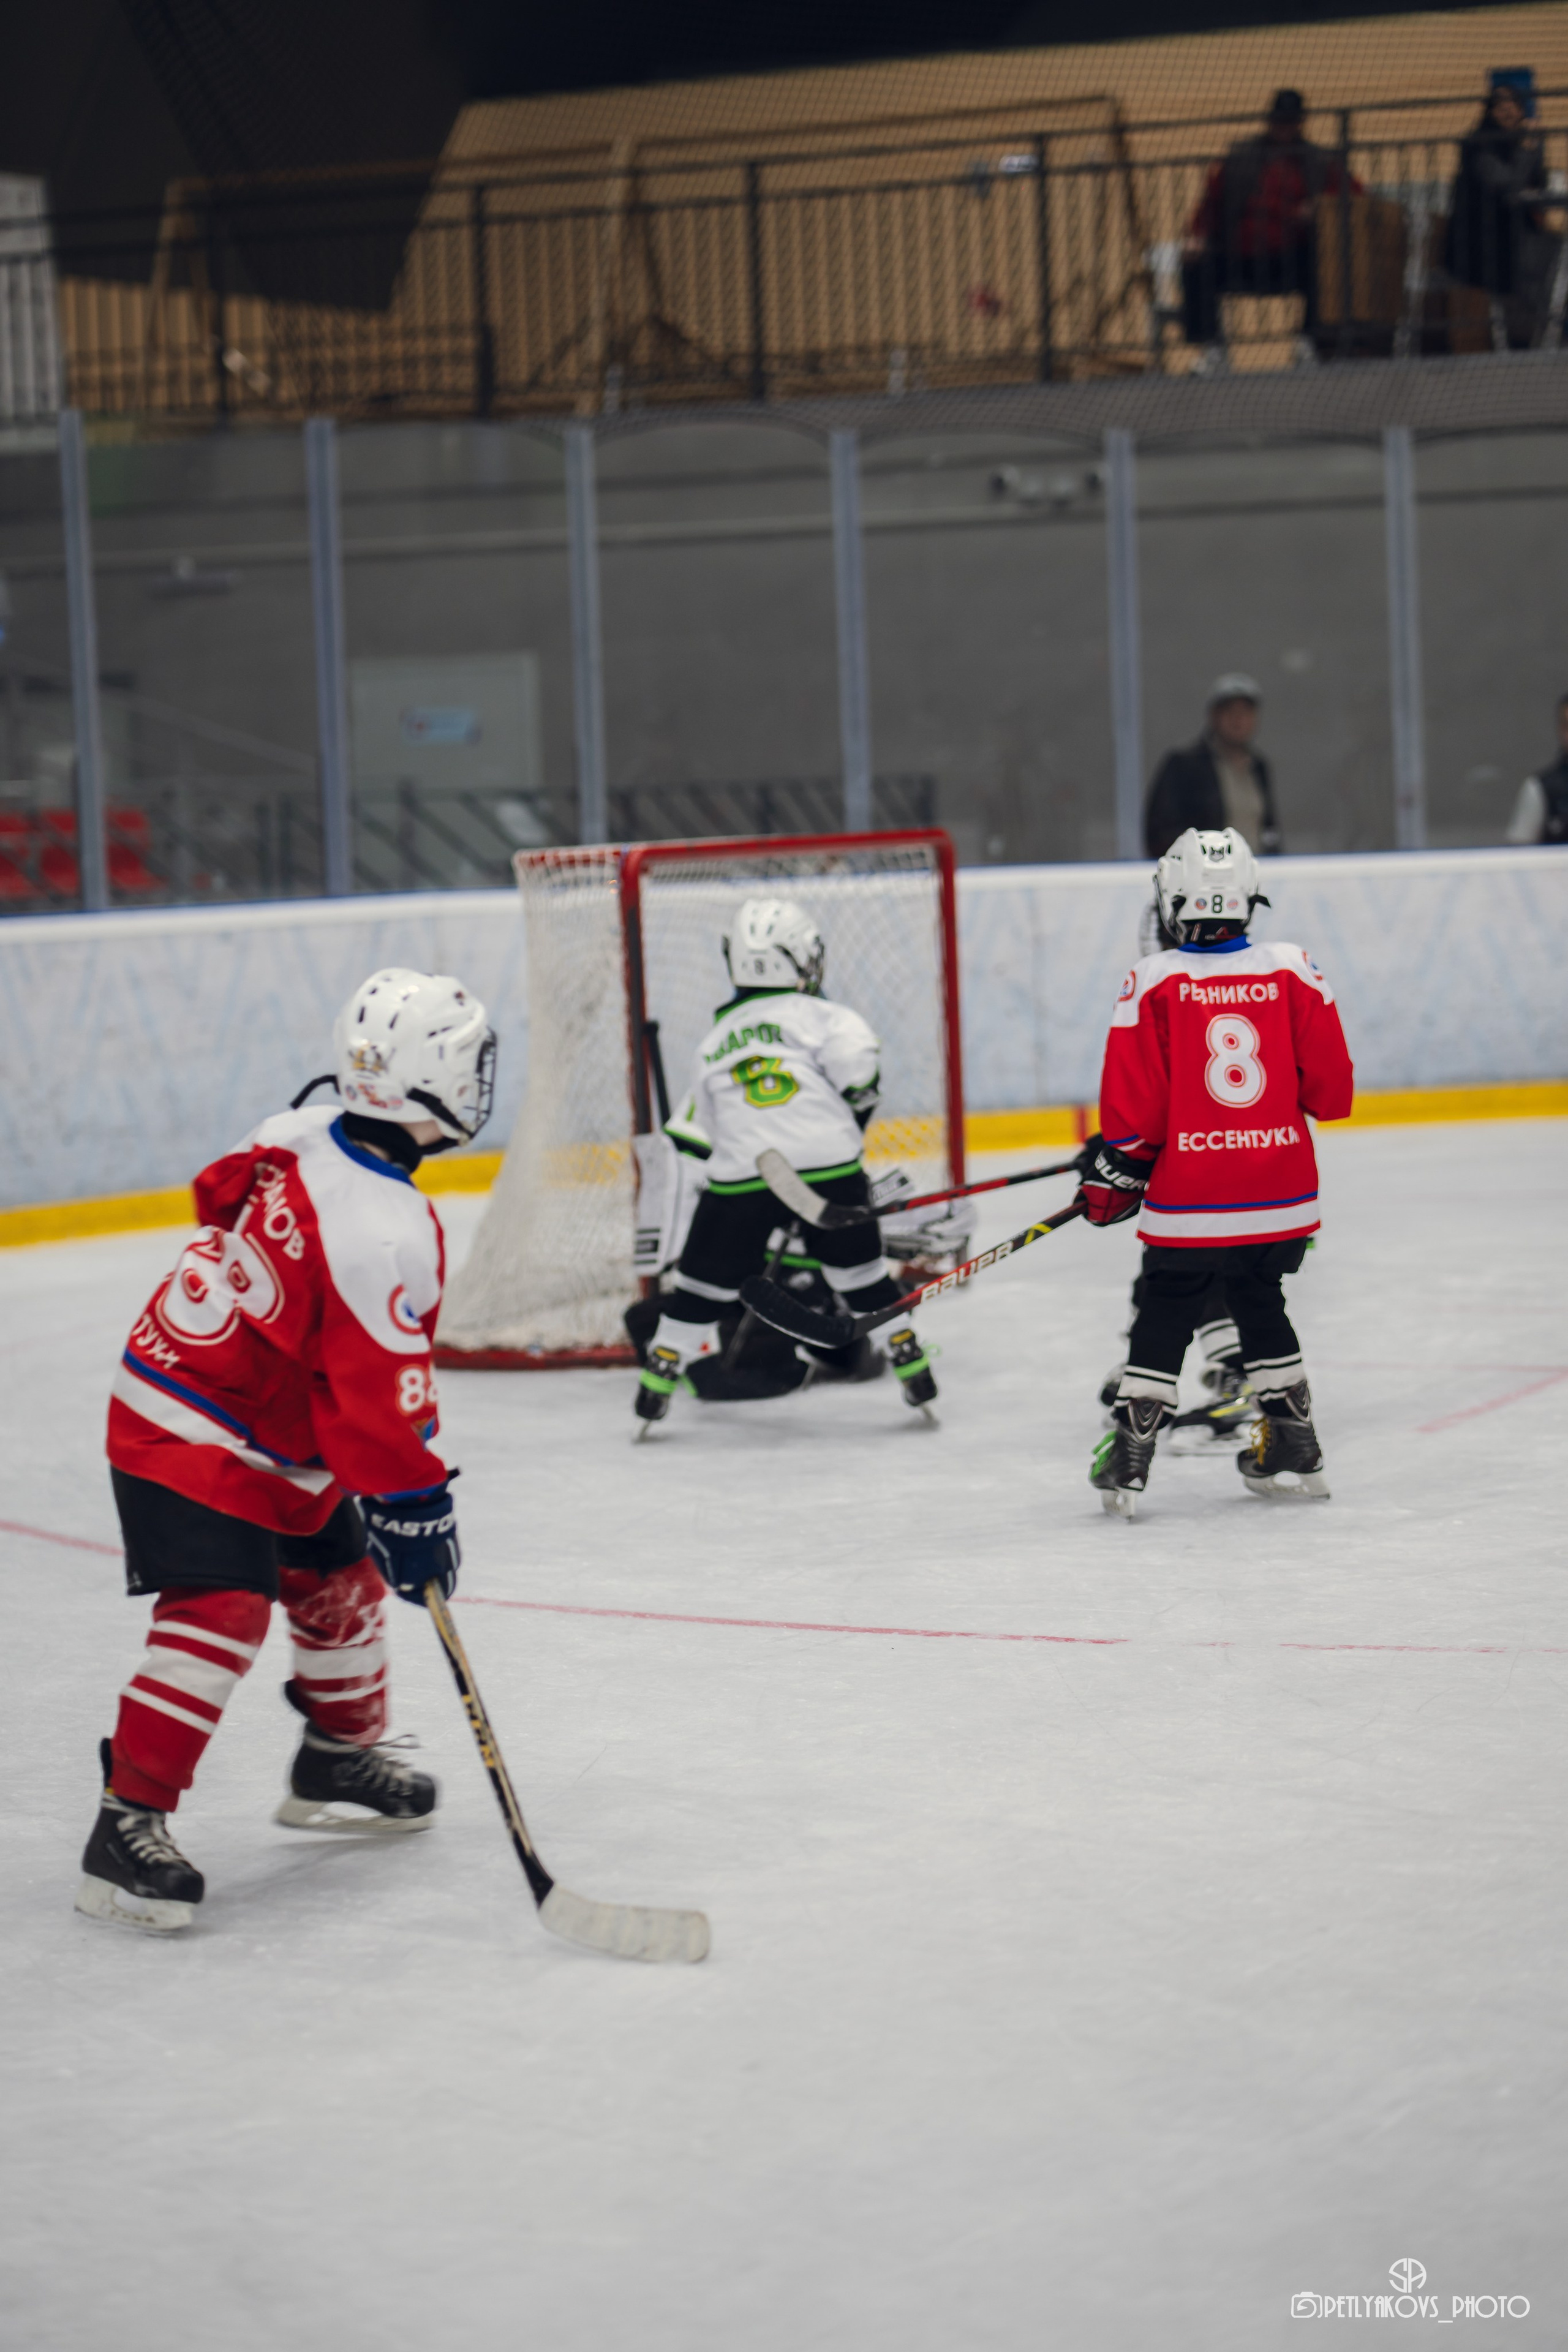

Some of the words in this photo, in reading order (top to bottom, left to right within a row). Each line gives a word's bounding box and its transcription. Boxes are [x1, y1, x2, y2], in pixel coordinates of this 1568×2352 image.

[1212, 894, 1223, 913] 8
[1204, 1012, 1267, 1109] 8
[371, 1512, 454, 1537] EASTO
